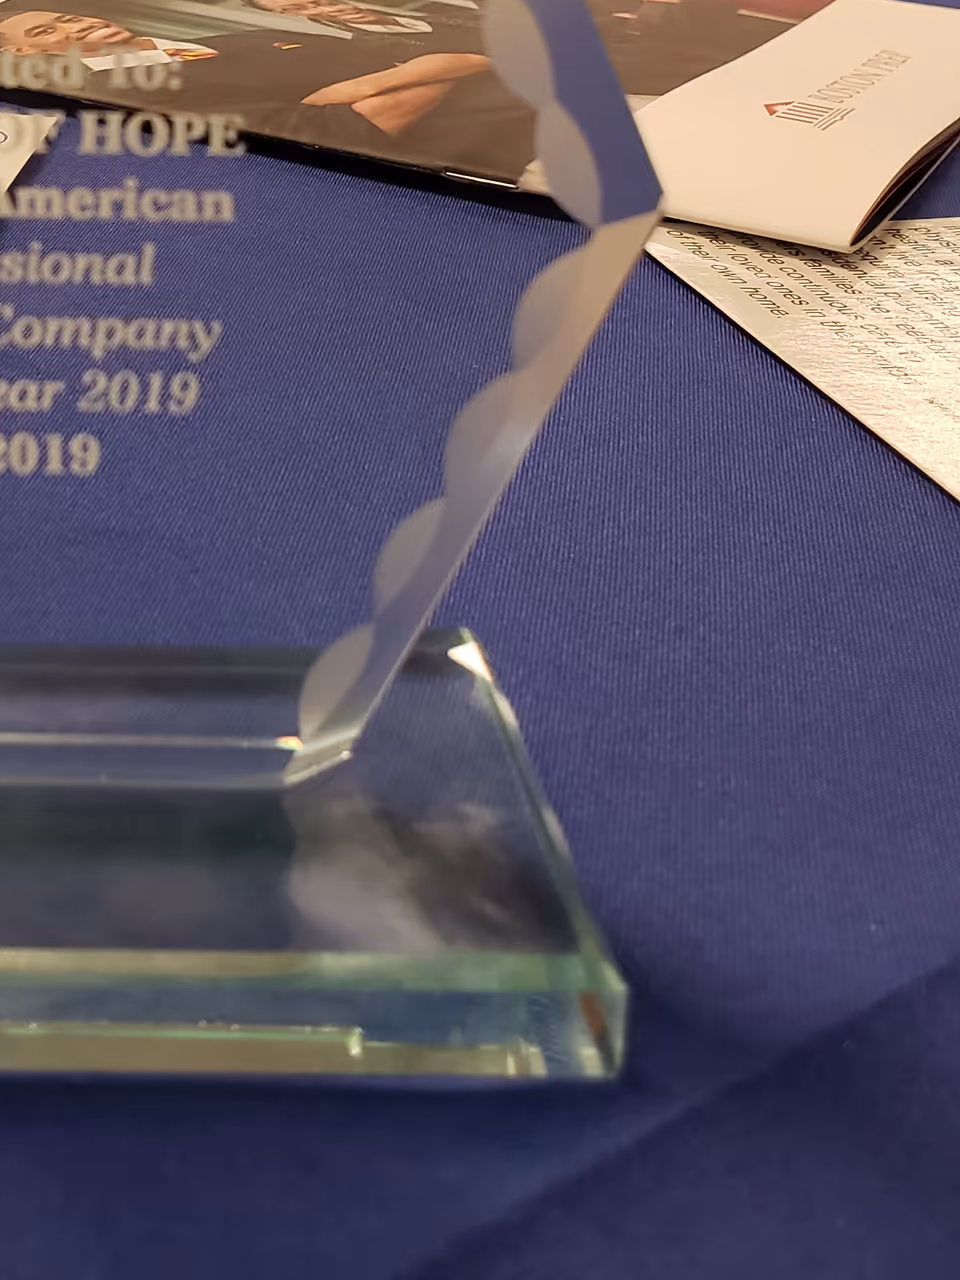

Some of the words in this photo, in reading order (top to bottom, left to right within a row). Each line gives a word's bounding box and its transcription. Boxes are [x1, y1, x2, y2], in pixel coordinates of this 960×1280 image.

[105, 47, 185, 92] To:
[78, 110, 249, 158] HOPE
[666, 228, 695, 240] of
[679, 241, 720, 262] their
[710, 264, 748, 284] own
[726, 253, 779, 279] loved
[765, 281, 810, 306] ones
[802, 308, 827, 318] in
[778, 267, 866, 321] continuous
[798, 258, 863, 295] families
[739, 287, 790, 319] home.
[76, 368, 203, 416] 2019
